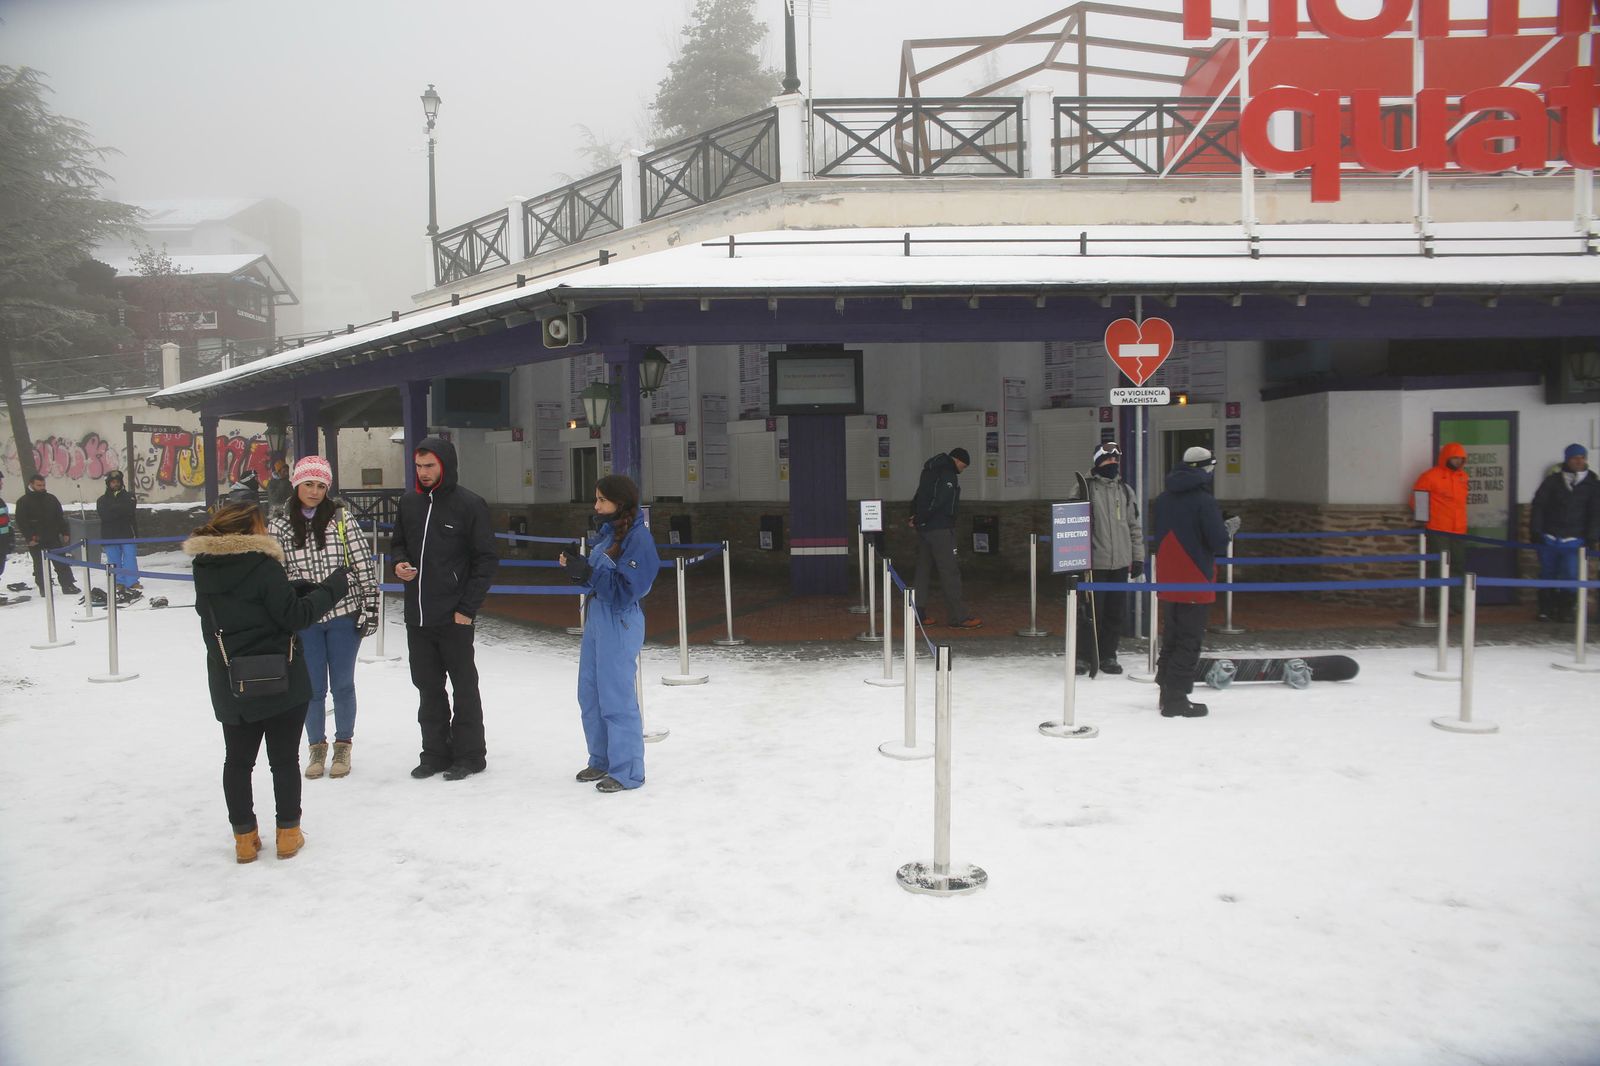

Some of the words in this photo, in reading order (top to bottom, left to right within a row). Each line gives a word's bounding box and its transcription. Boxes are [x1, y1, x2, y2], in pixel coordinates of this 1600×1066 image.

[1476, 466, 1504, 477] HASTA
[1467, 480, 1482, 491] STA
[1466, 493, 1489, 504] EGRA
[1067, 516, 1090, 524] EXCLUSIVO
[1064, 530, 1088, 538] EFECTIVO
[1059, 559, 1087, 567] GRACIAS
